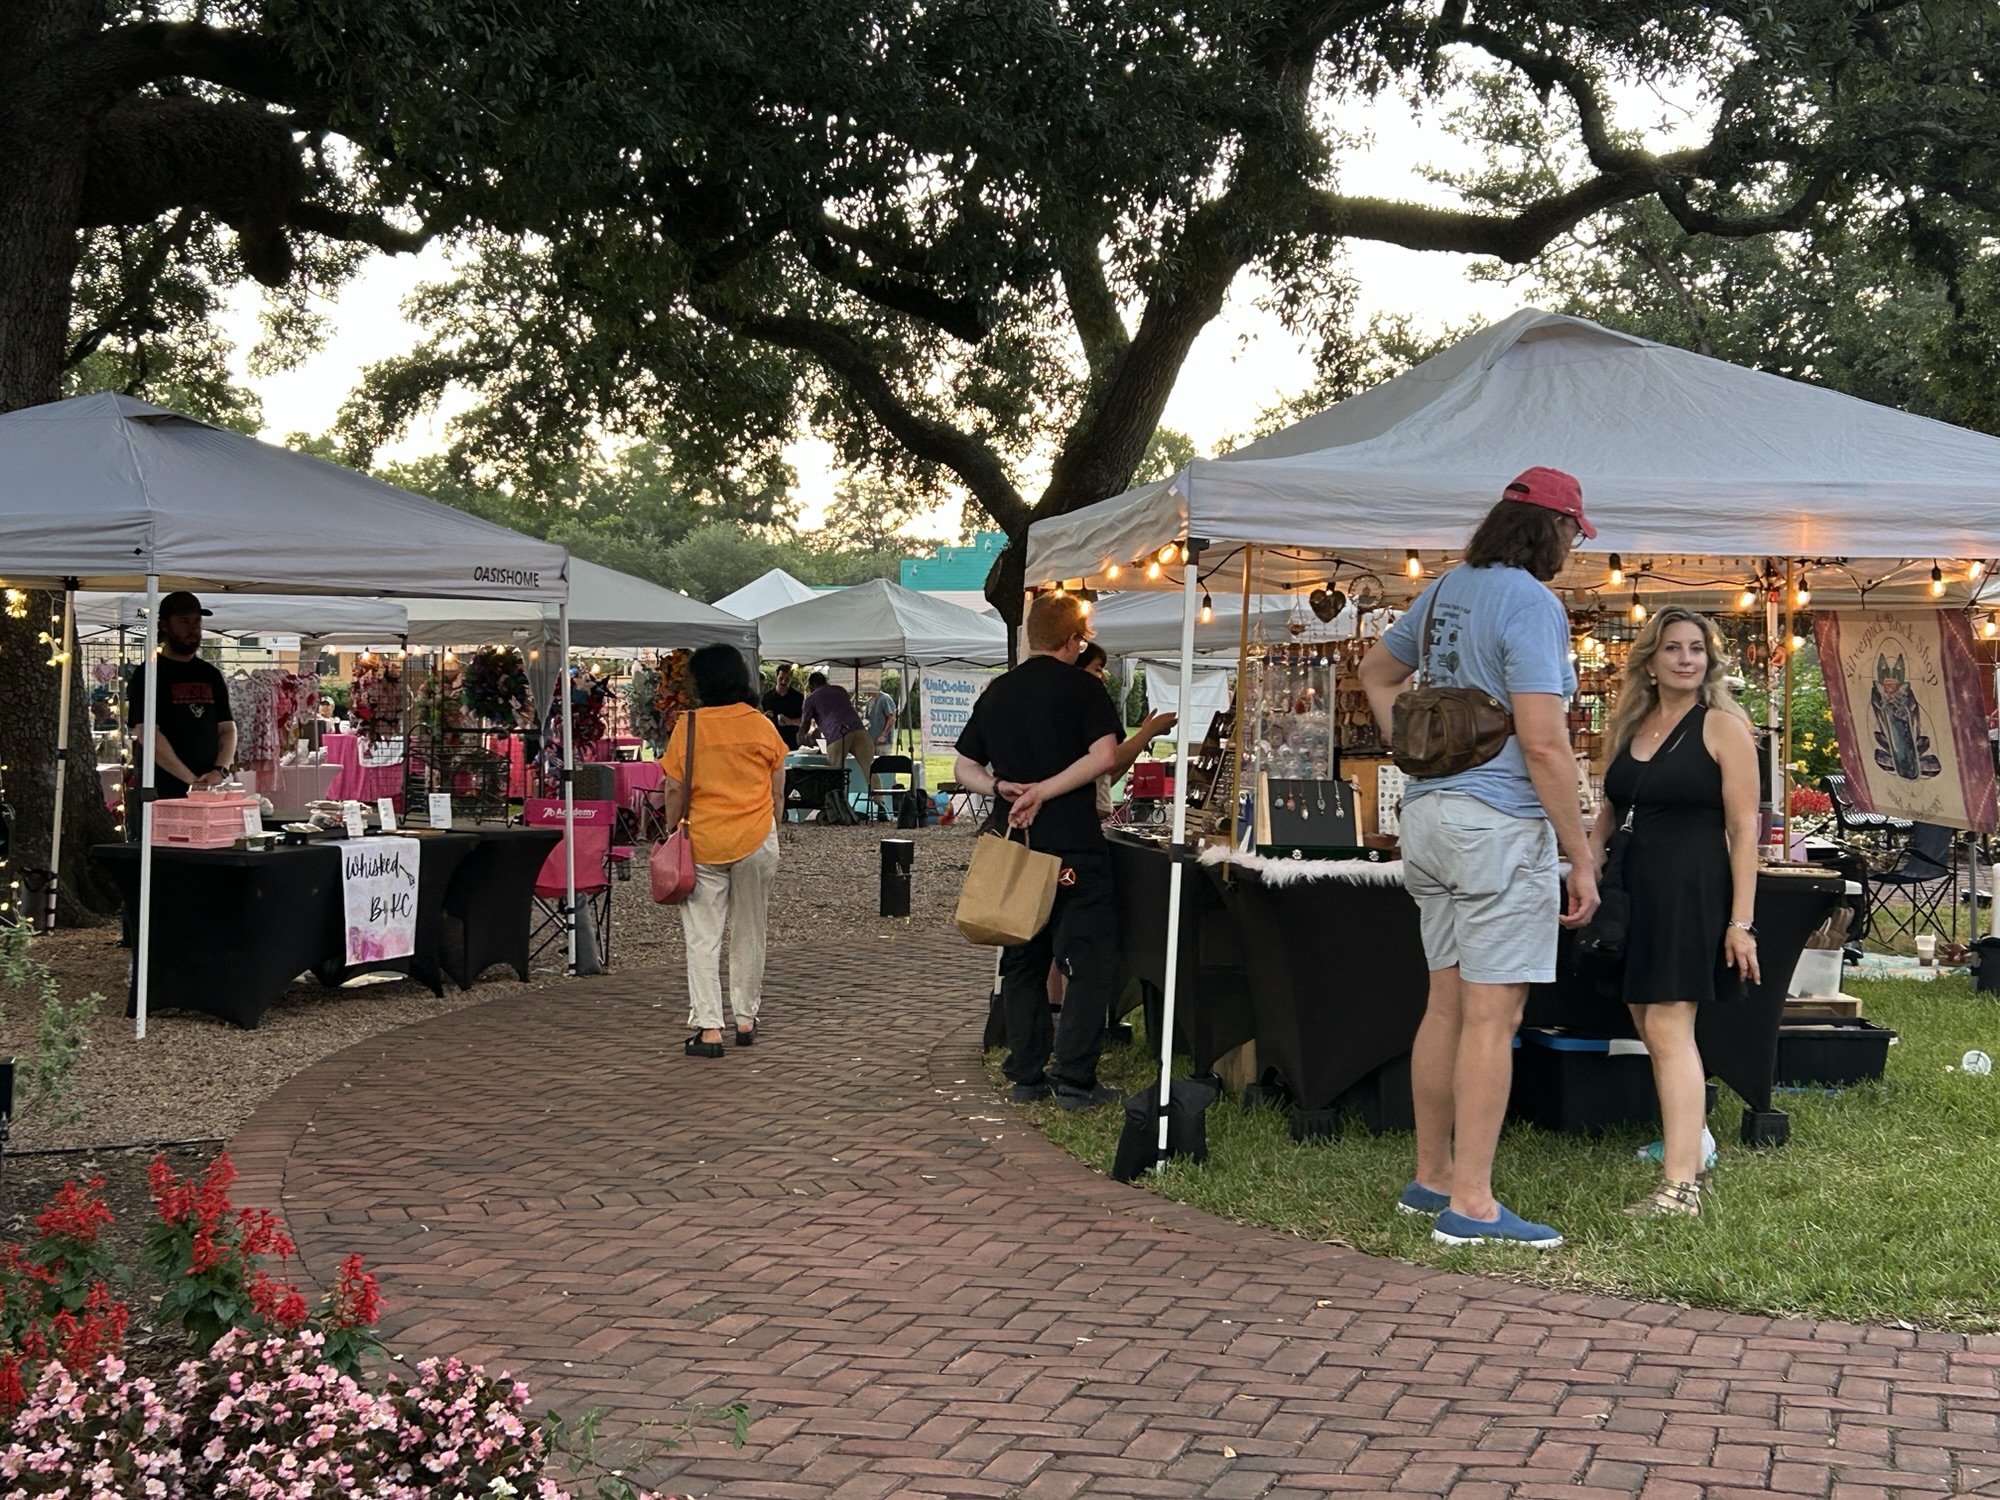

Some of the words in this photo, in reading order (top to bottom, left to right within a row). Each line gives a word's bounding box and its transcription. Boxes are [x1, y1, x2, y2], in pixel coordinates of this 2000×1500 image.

[474, 566, 540, 588] OASISHOME
[930, 709, 970, 722] STUFFED
[556, 807, 598, 818] Acdemy
[346, 851, 399, 880] Whisked
[369, 896, 388, 927] By
[390, 893, 413, 918] KC
